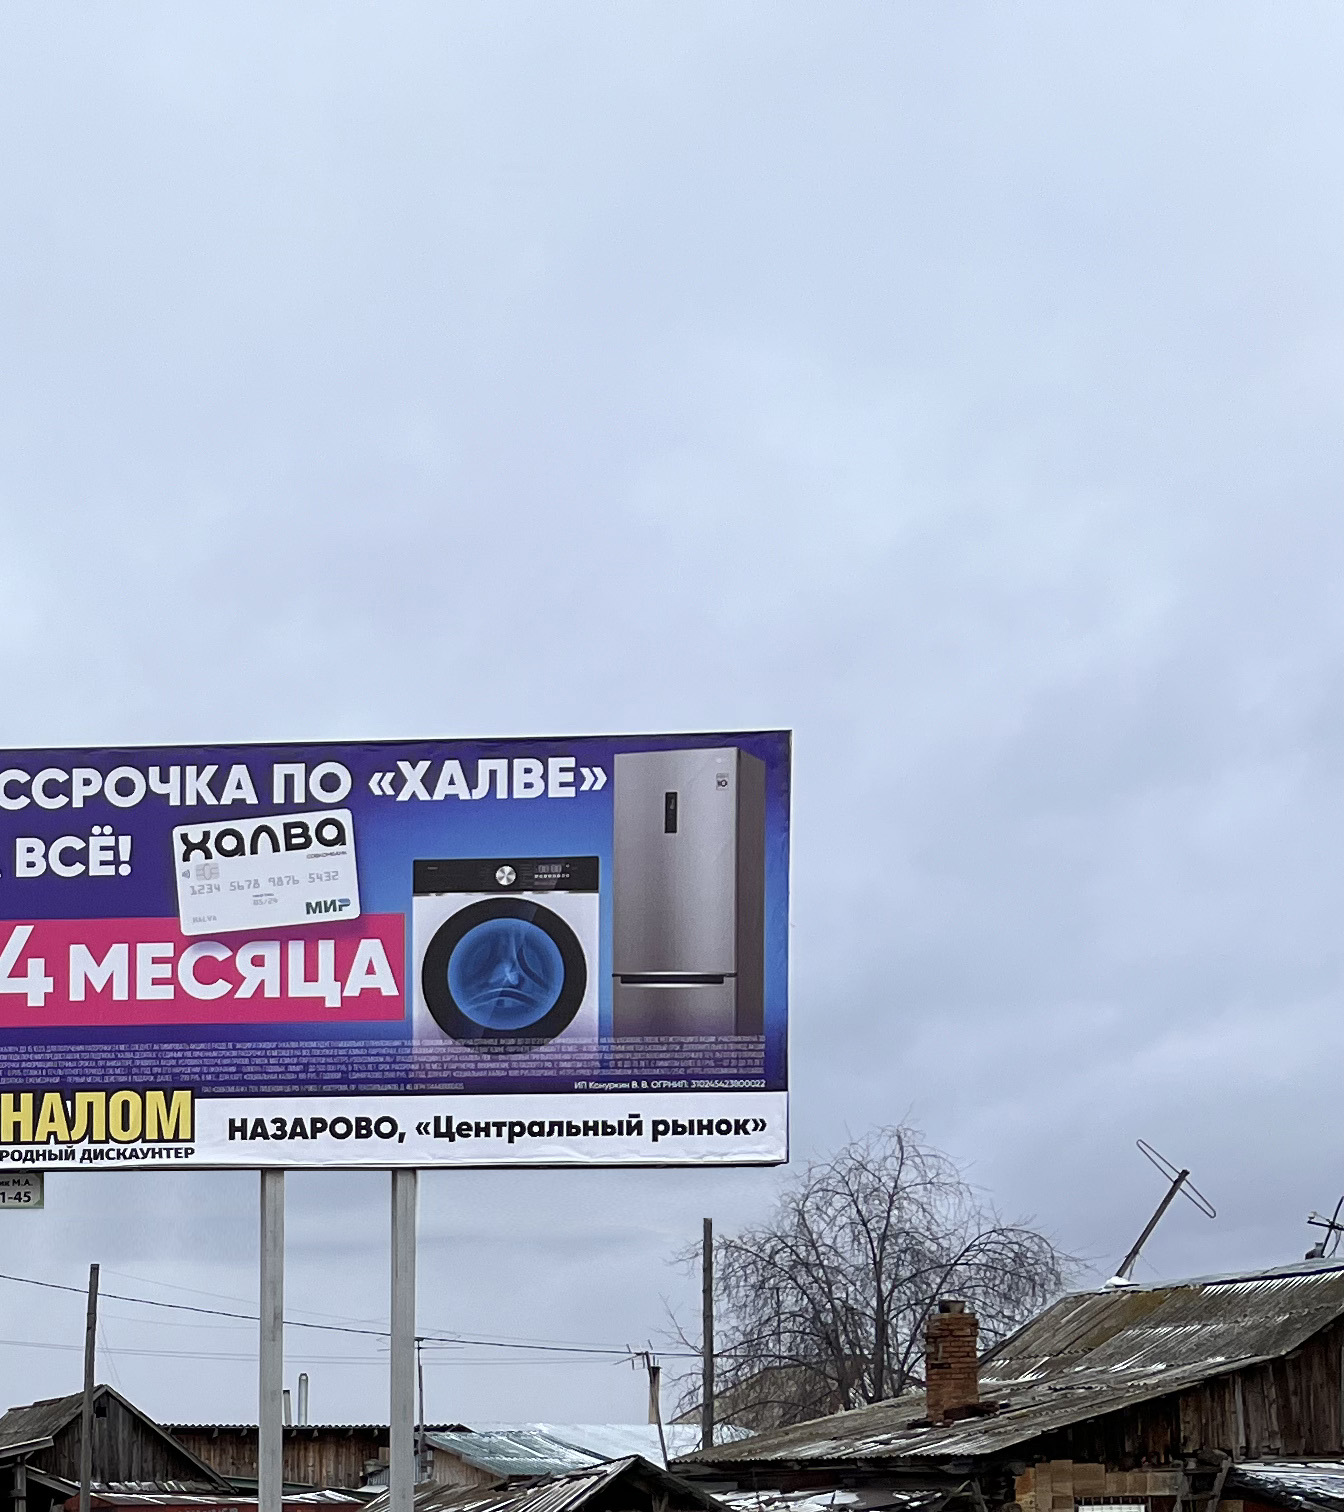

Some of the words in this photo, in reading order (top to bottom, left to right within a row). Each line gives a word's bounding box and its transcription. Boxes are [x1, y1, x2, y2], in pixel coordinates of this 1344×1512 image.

[272, 760, 353, 806] ПО
[368, 756, 608, 801] «ХАЛВЕ»
[15, 825, 132, 878] ВСЁ!
[189, 883, 221, 896] 1234
[229, 878, 261, 892] 5678
[268, 874, 300, 888] 9876
[308, 870, 339, 883] 5432
[305, 898, 351, 915] МИР
[69, 938, 400, 1008] МЕСЯЦА
[574, 1081, 587, 1089] ИП
[228, 1116, 407, 1143] НАЗАРОВО,
[415, 1113, 644, 1143] «Центральный
[651, 1116, 768, 1142] рынок»
[79, 1147, 196, 1163] ДИСКАУНТЕР
[12, 1179, 33, 1187] М.А.
